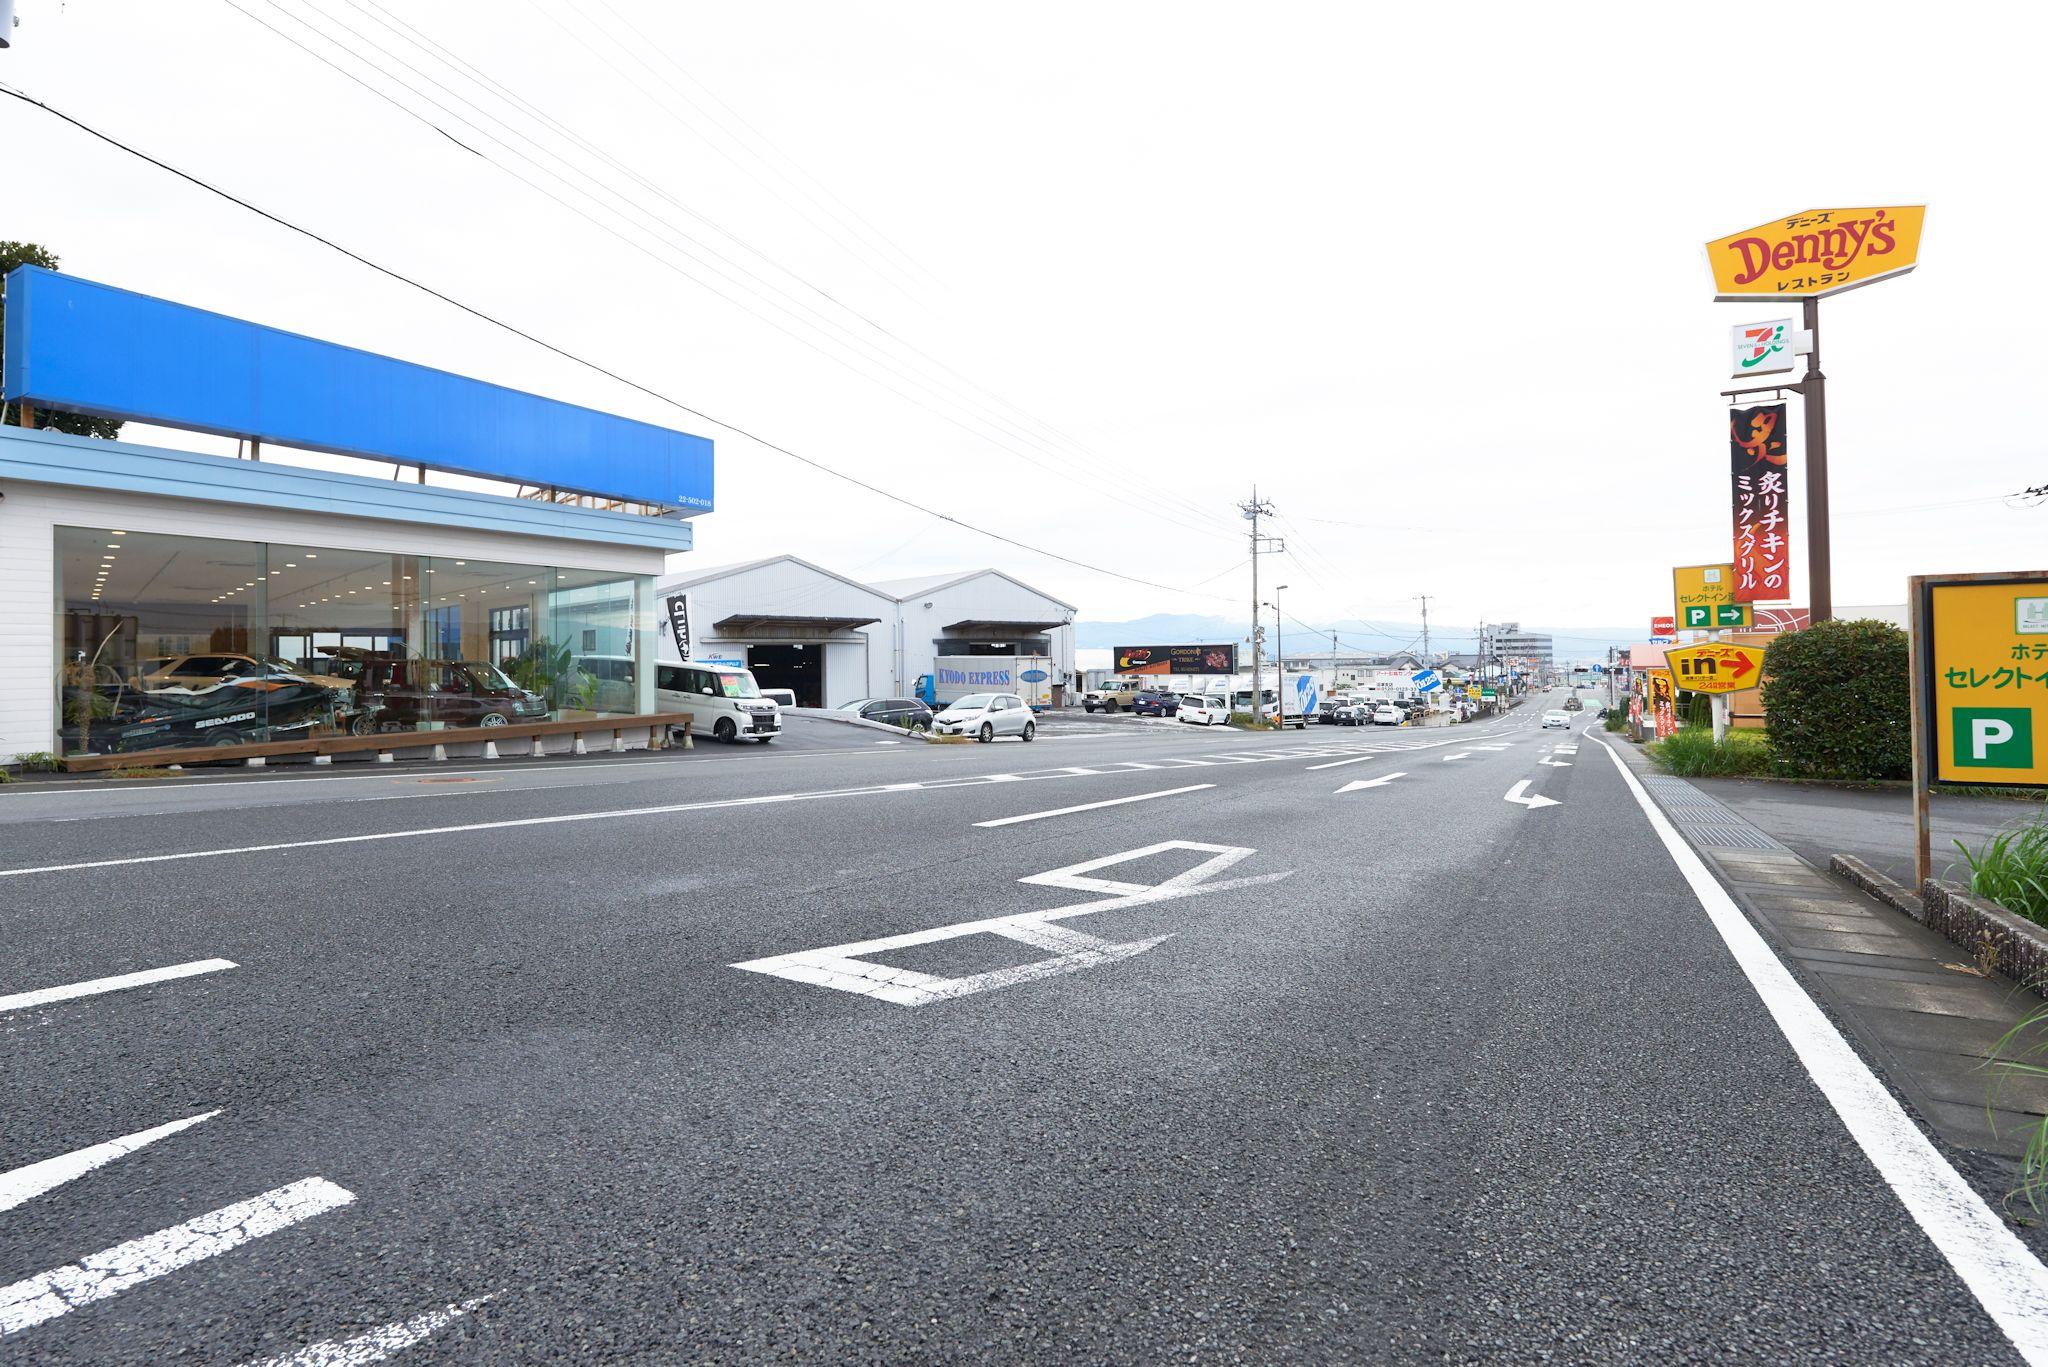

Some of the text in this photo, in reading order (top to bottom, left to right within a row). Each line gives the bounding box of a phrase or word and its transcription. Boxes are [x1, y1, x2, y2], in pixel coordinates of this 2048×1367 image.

[1787, 211, 1835, 229] デニーズ
[1728, 209, 1896, 285] Denny's
[1777, 271, 1850, 292] レストラン
[1737, 474, 1757, 590] ミックスグリル
[1758, 470, 1786, 589] 炙りチキンの
[1702, 584, 1724, 592] ホテル
[1691, 609, 1706, 625] P
[1696, 648, 1734, 657] デニーズ
[1680, 657, 1717, 675] in
[938, 668, 966, 686] KYODO
[968, 669, 1010, 686] EXPRESS
[1415, 673, 1437, 689] 0123
[1972, 718, 2014, 760] P
